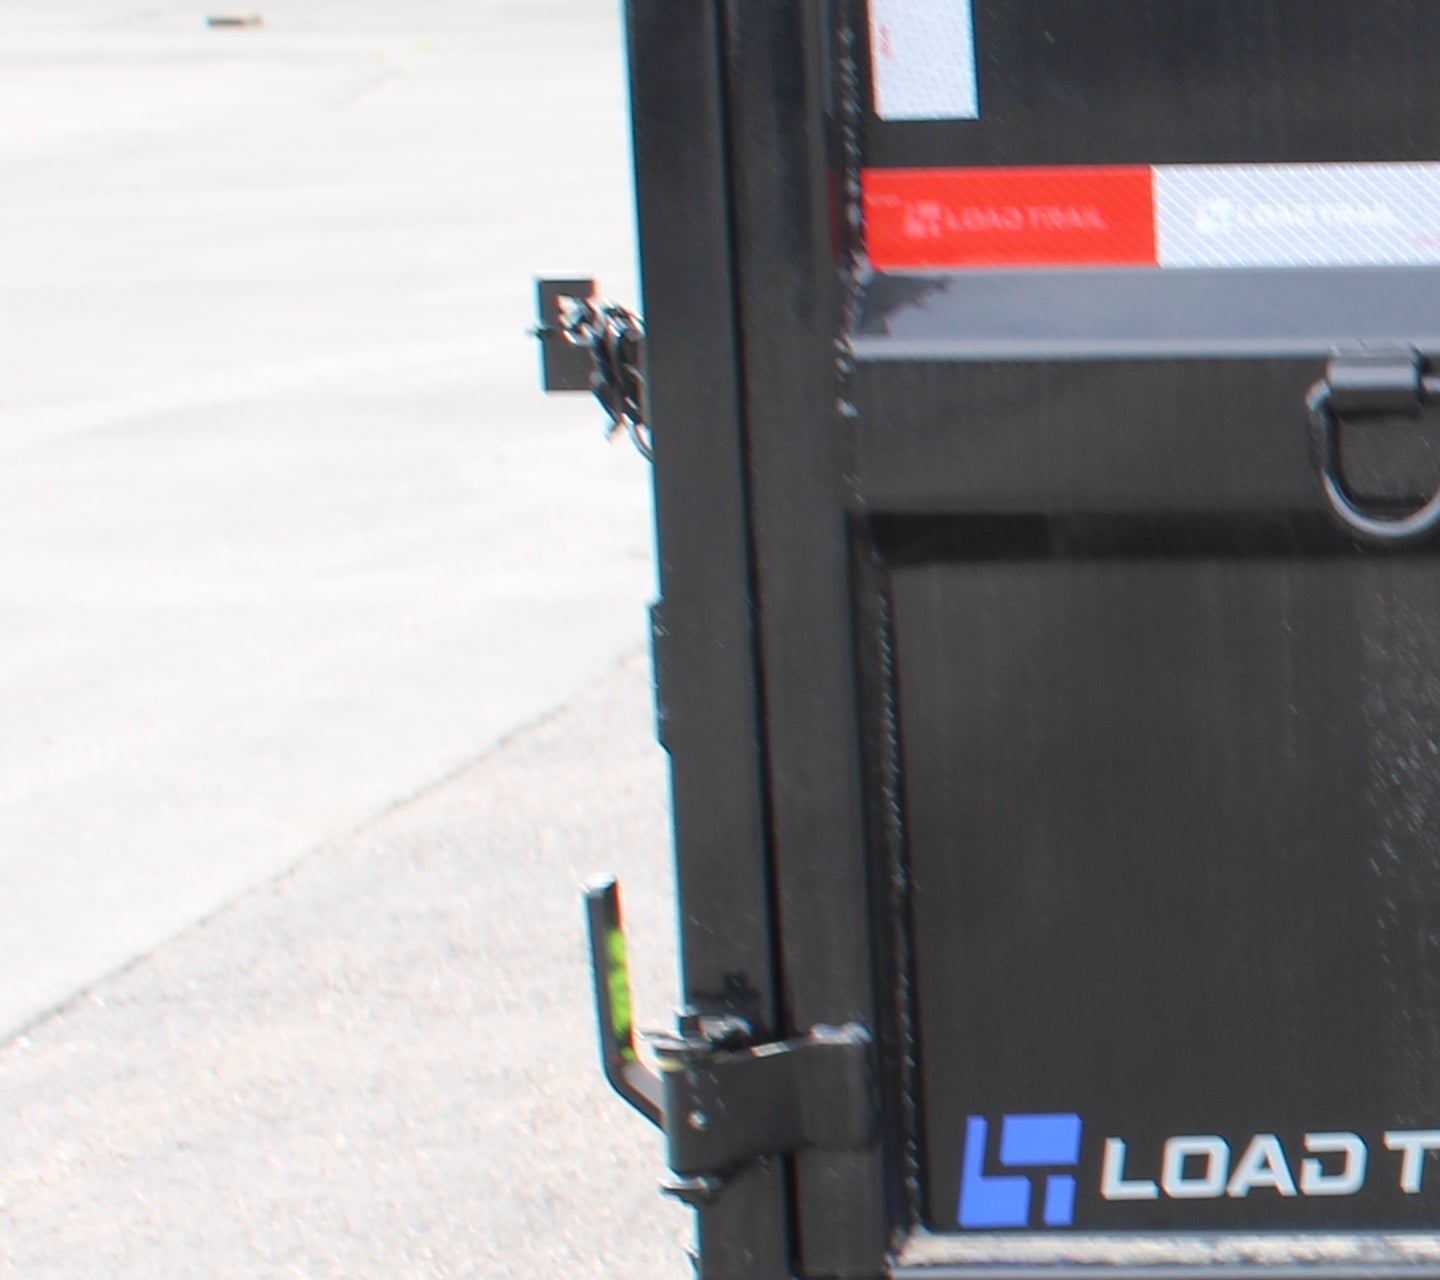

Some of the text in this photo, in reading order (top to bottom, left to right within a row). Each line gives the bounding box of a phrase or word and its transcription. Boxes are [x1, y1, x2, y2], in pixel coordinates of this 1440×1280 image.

[945, 204, 1107, 233] LOAD TRAIL
[1100, 1131, 1368, 1201] LOAD
